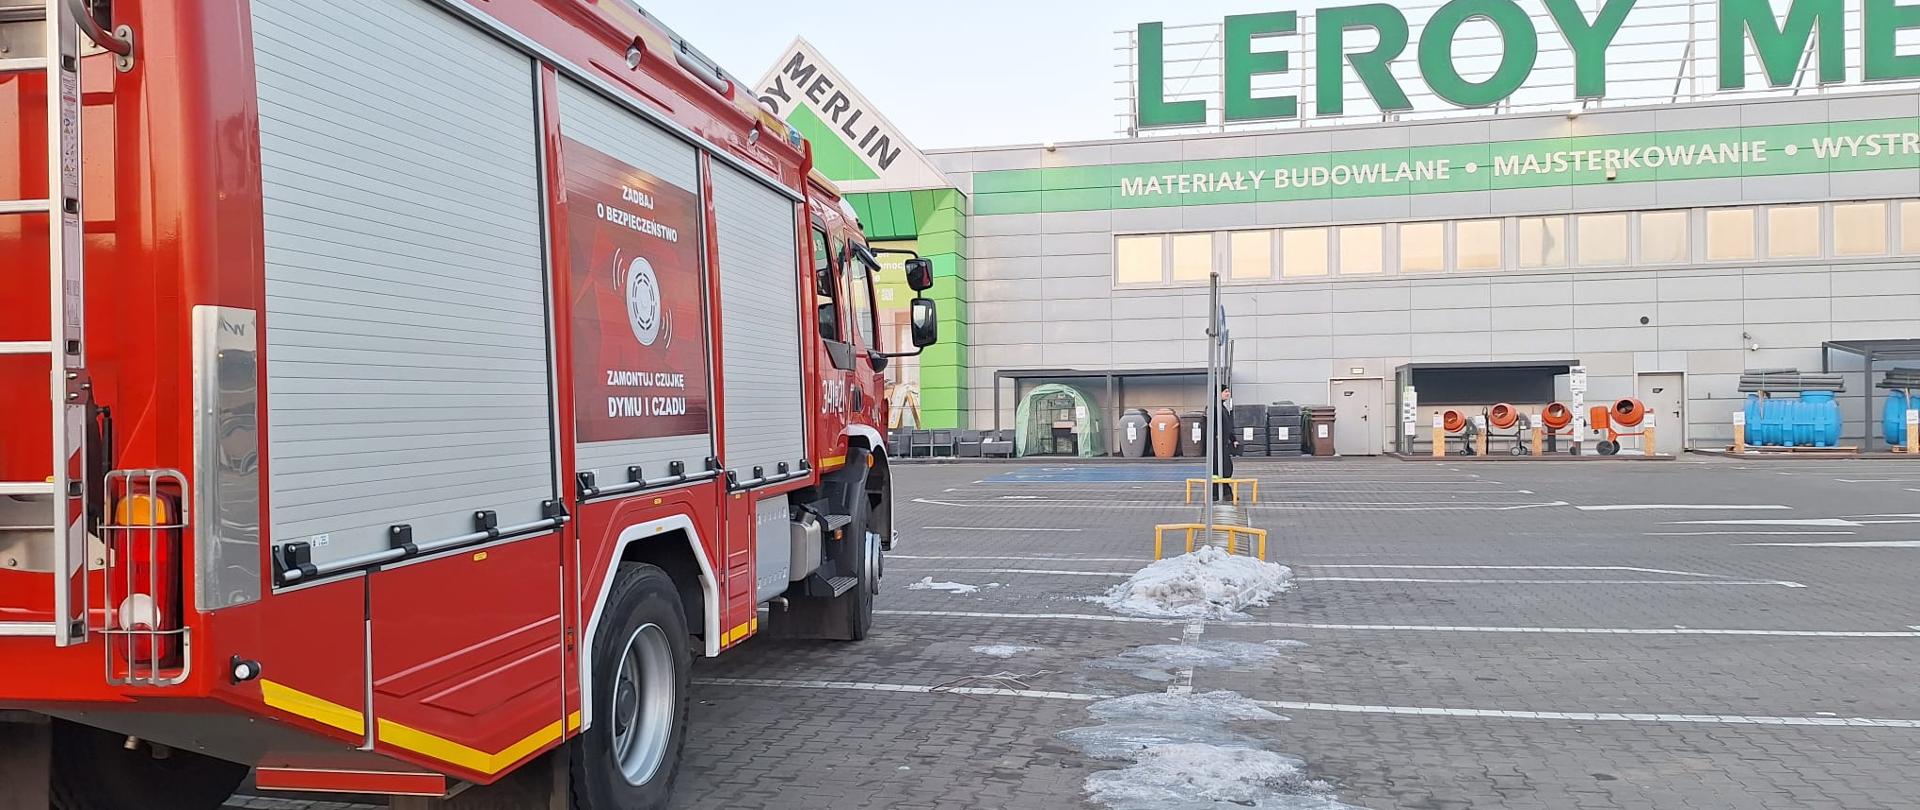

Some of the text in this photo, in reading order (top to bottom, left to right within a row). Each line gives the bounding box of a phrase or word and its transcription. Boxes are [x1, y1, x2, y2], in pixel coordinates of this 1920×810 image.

[1137, 0, 1637, 129] LEROY
[782, 51, 902, 171] MERLIN
[1120, 132, 1920, 198] MATERIAŁY BUDOWLANE MAJSTERKOWANIE WYSTR
[622, 185, 654, 210] ZADBAJ
[597, 202, 678, 243] O BEZPIECZEŃSTWO
[607, 370, 685, 391] ZAMONTUJ CZUJKĘ
[608, 396, 686, 418] DYMU I CZADU
